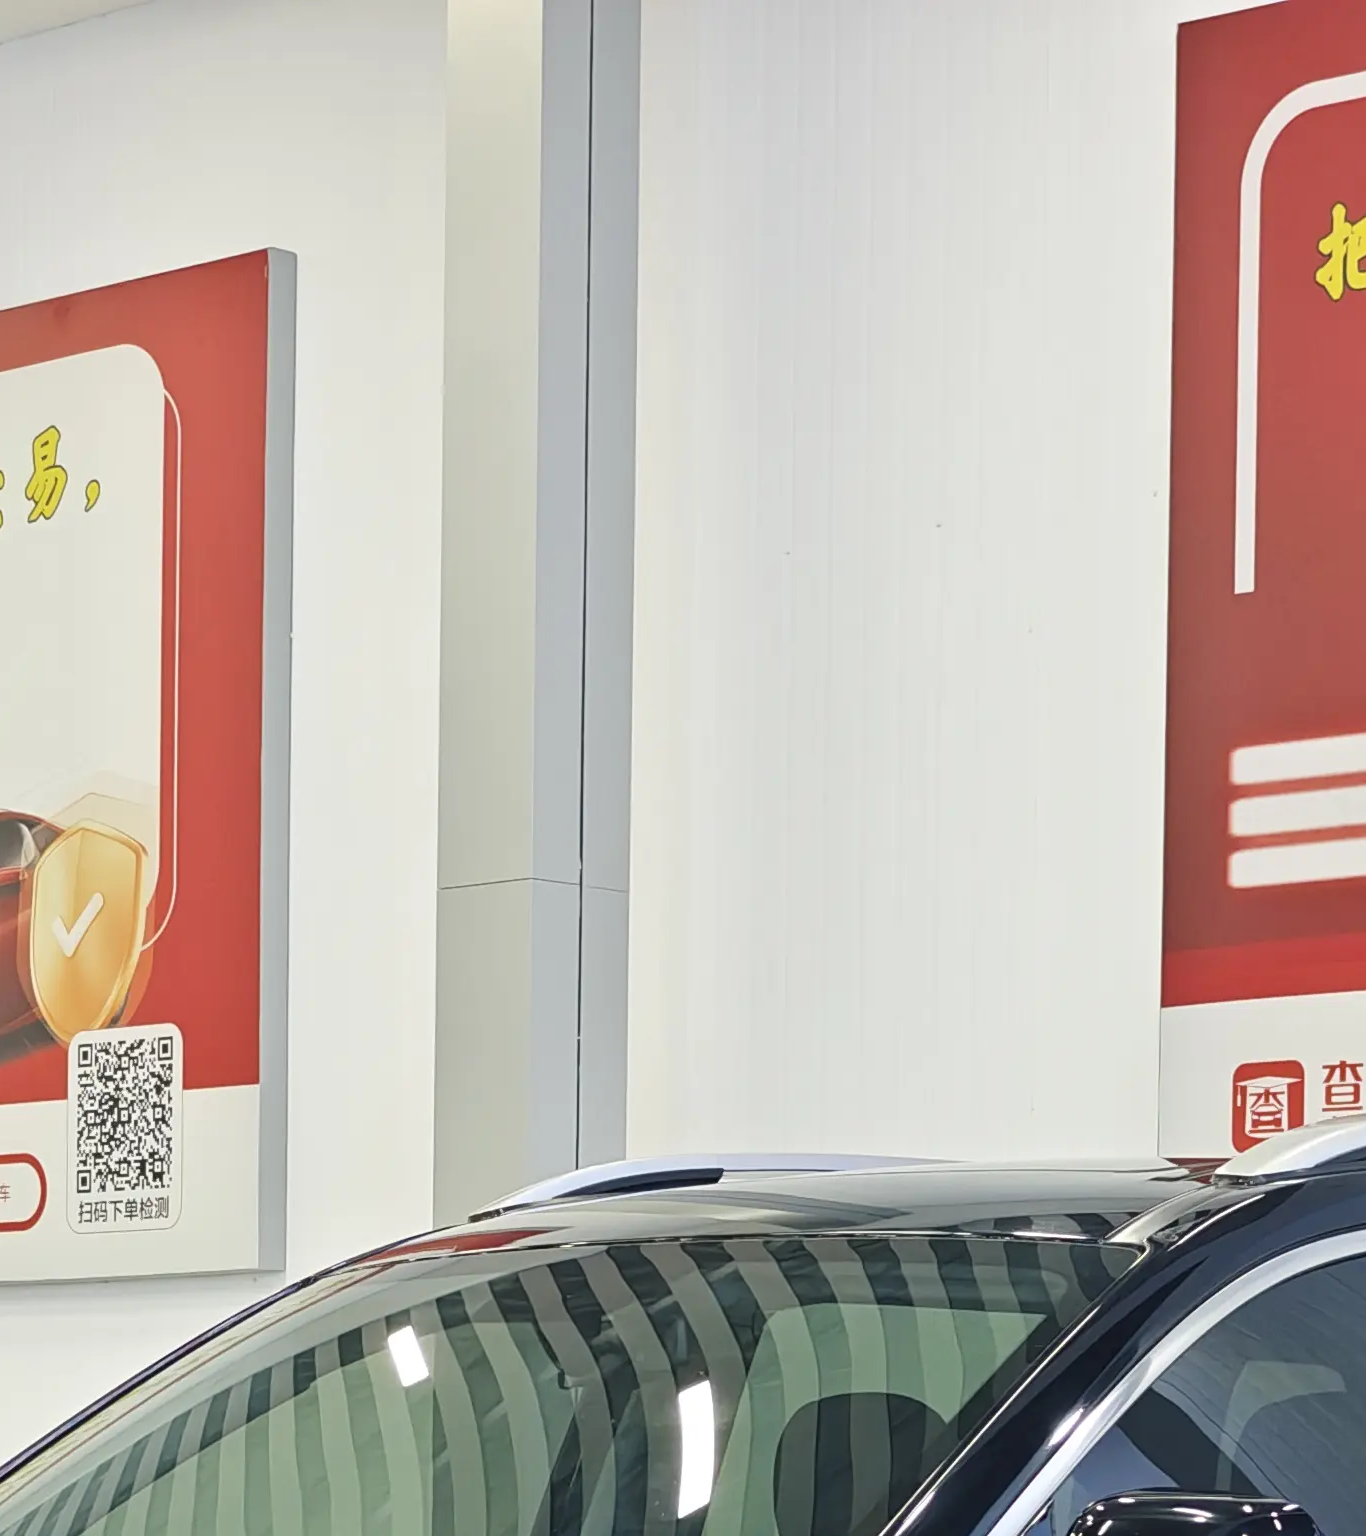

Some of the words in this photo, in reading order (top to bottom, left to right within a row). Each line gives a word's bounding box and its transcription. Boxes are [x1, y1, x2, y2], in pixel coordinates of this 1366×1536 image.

[78, 1195, 170, 1223] 扫码下单检测
